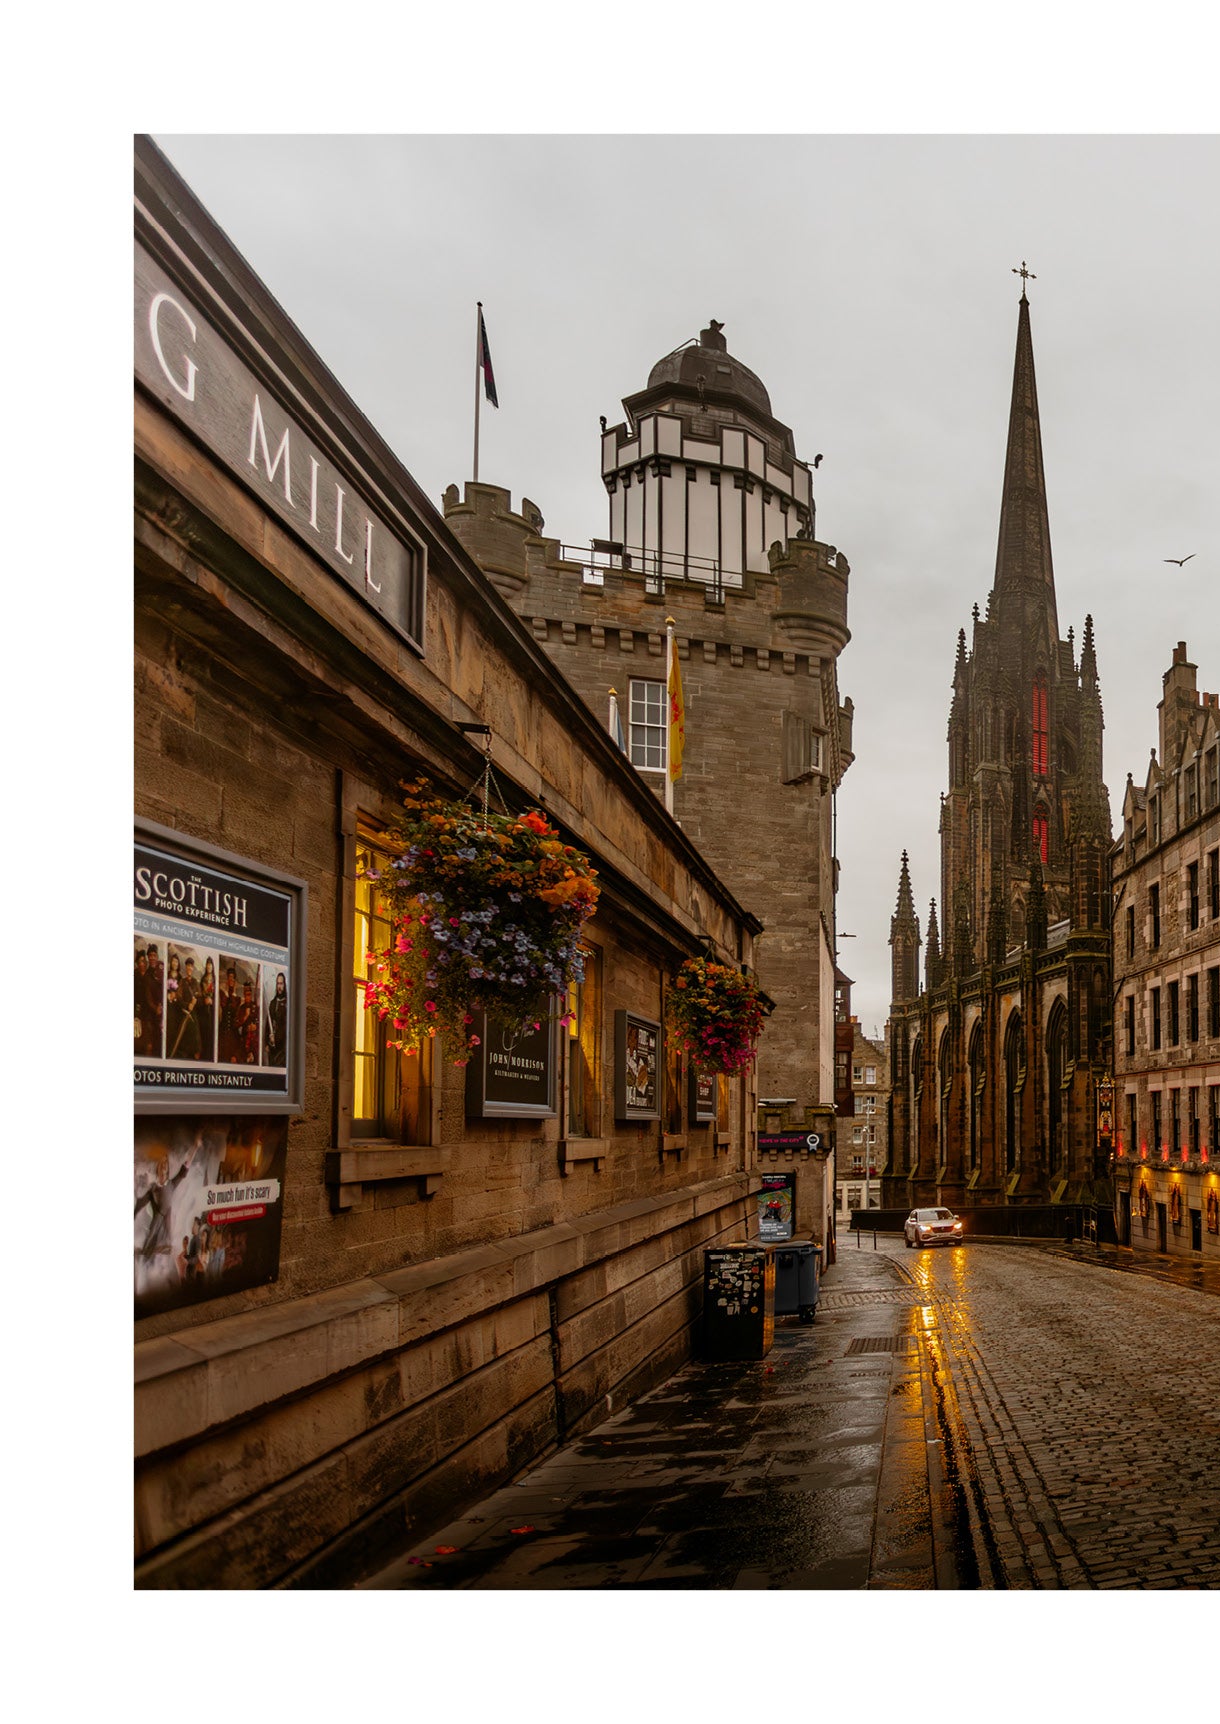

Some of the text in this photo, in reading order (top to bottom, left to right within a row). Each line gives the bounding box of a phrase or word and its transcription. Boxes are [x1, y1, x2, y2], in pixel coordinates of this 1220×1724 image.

[149, 292, 382, 594] G MILL
[191, 875, 202, 883] THE
[135, 867, 248, 928] SCOTTISH
[155, 898, 229, 925] PHOTO EXPERIENCE
[151, 920, 160, 930] IN
[162, 925, 194, 938] ANCIENT
[196, 933, 227, 946] SCOTTISH
[228, 940, 259, 955] HIGHLAND
[489, 1052, 544, 1070] JOHN MORRISON
[164, 1072, 205, 1085] PRINTED
[208, 1074, 253, 1087] INSTANTLY
[207, 1186, 271, 1205] So much fun it's scary
